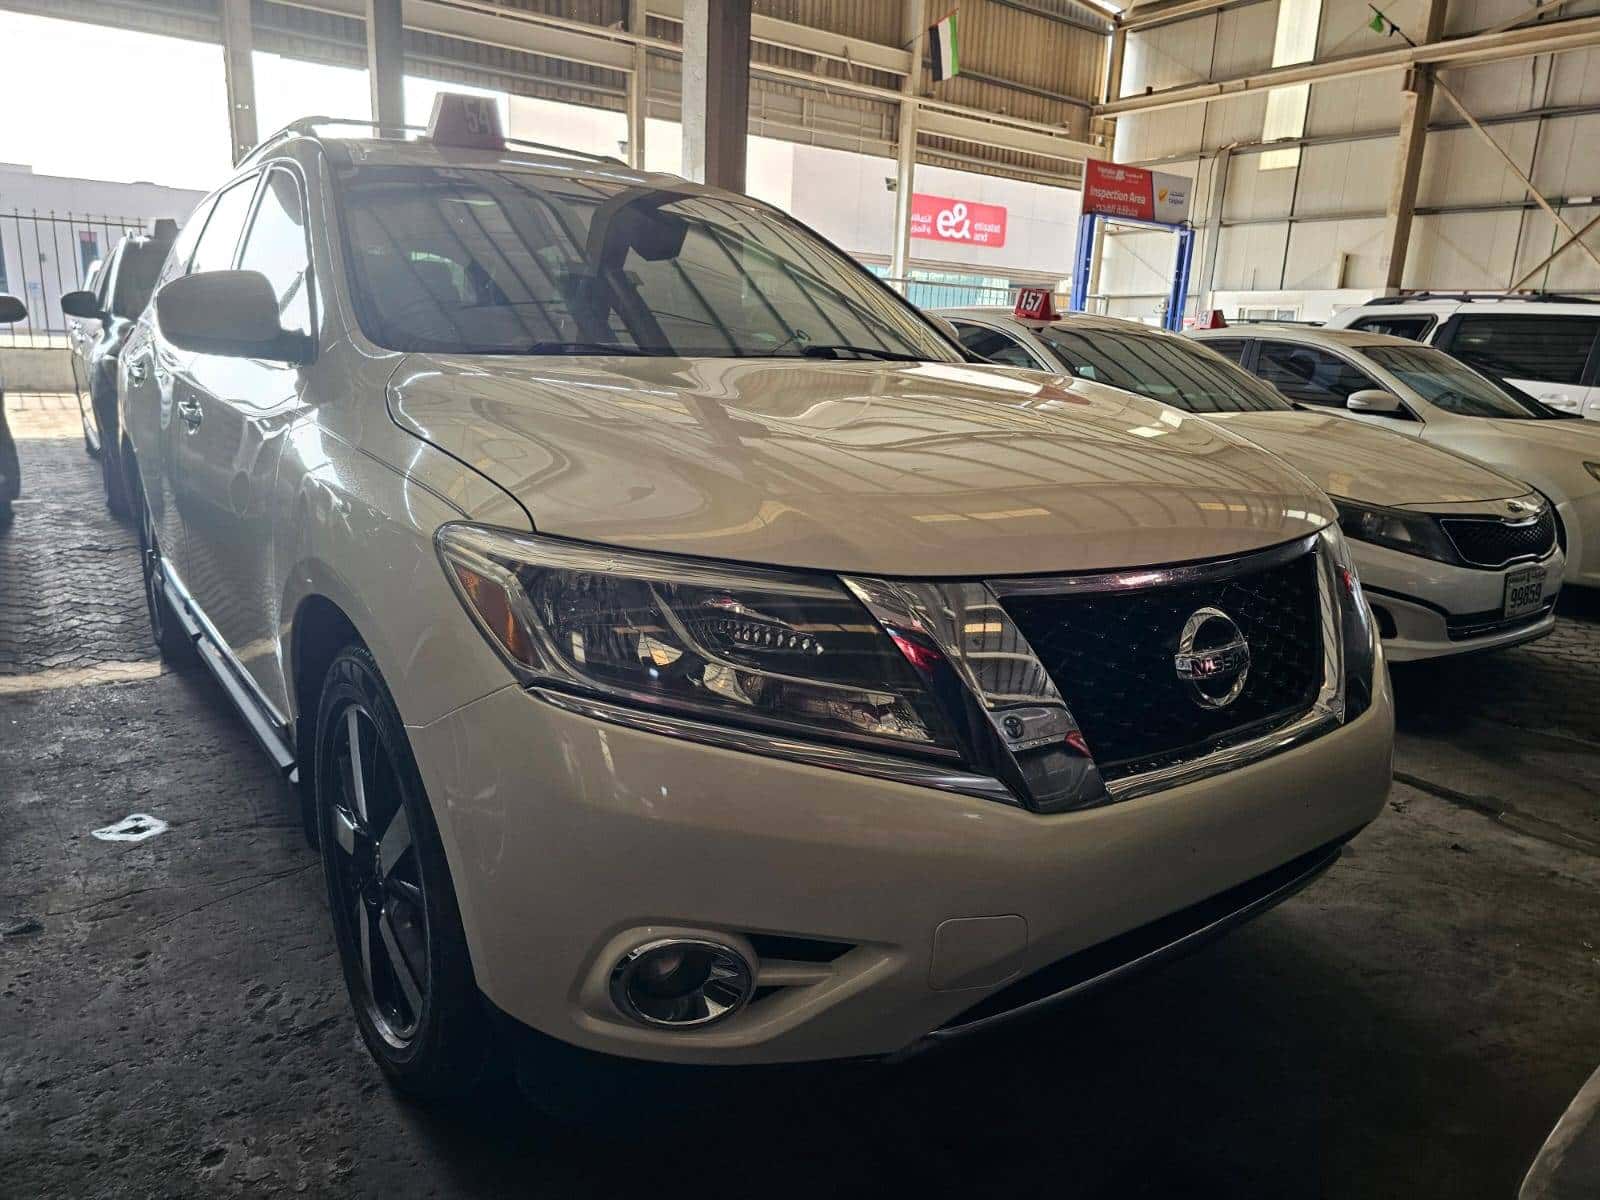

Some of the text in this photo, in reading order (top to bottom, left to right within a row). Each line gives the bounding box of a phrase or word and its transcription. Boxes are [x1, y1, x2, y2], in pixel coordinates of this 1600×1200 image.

[1090, 185, 1146, 205] Inspection Area
[974, 222, 1001, 233] etisalat
[973, 232, 988, 241] and
[1021, 291, 1043, 311] 157
